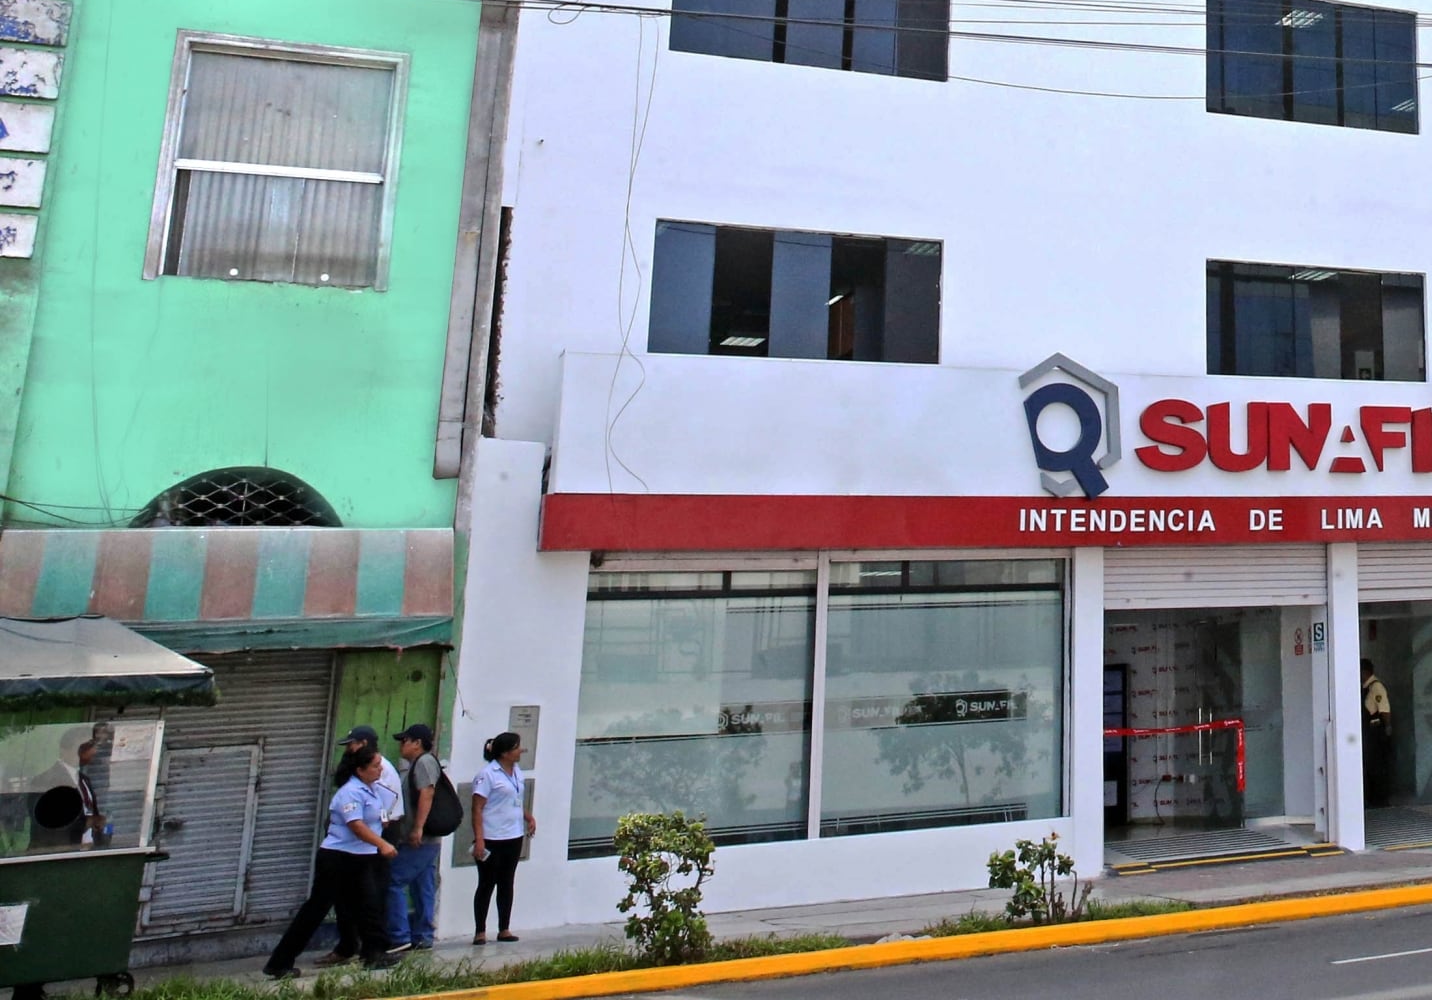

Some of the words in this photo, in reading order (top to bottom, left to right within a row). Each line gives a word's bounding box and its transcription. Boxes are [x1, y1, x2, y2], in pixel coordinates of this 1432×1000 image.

[1019, 508, 1216, 533] INTENDENCIA
[1249, 508, 1284, 531] DE
[1321, 507, 1383, 530] LIMA
[1315, 624, 1323, 640] S
